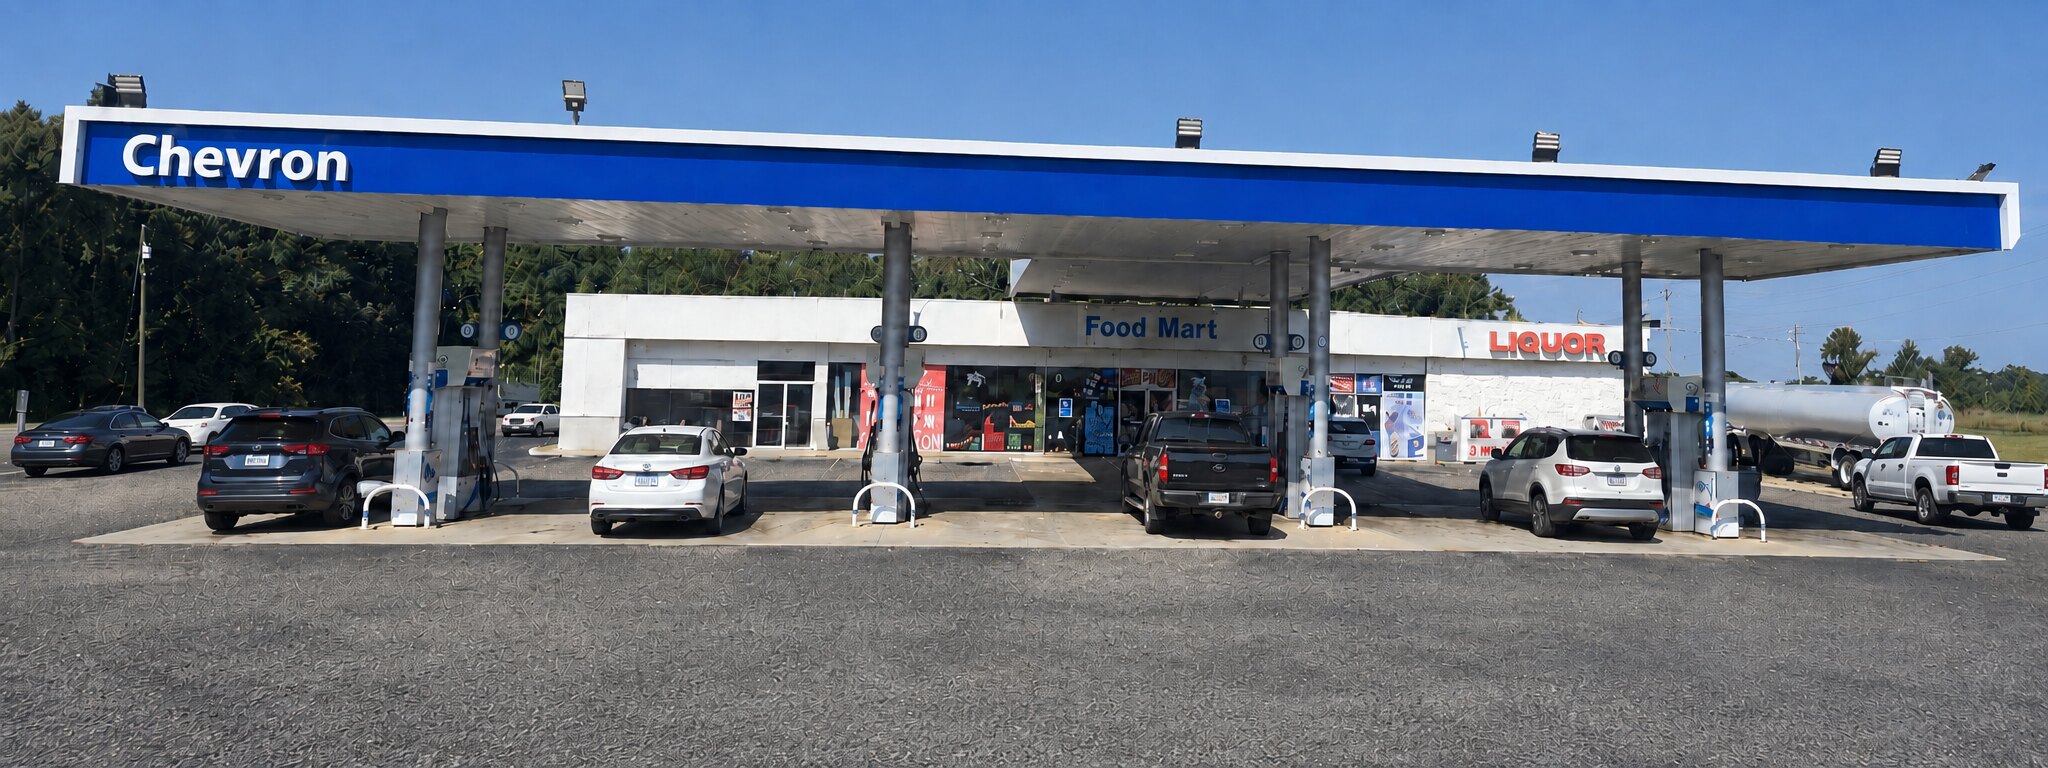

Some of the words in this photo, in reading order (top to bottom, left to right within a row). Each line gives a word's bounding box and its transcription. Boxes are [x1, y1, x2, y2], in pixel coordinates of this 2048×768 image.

[122, 133, 350, 182] Chevron
[1086, 315, 1146, 337] Food
[1158, 316, 1217, 339] Mart
[1489, 331, 1606, 355] LIQUOR
